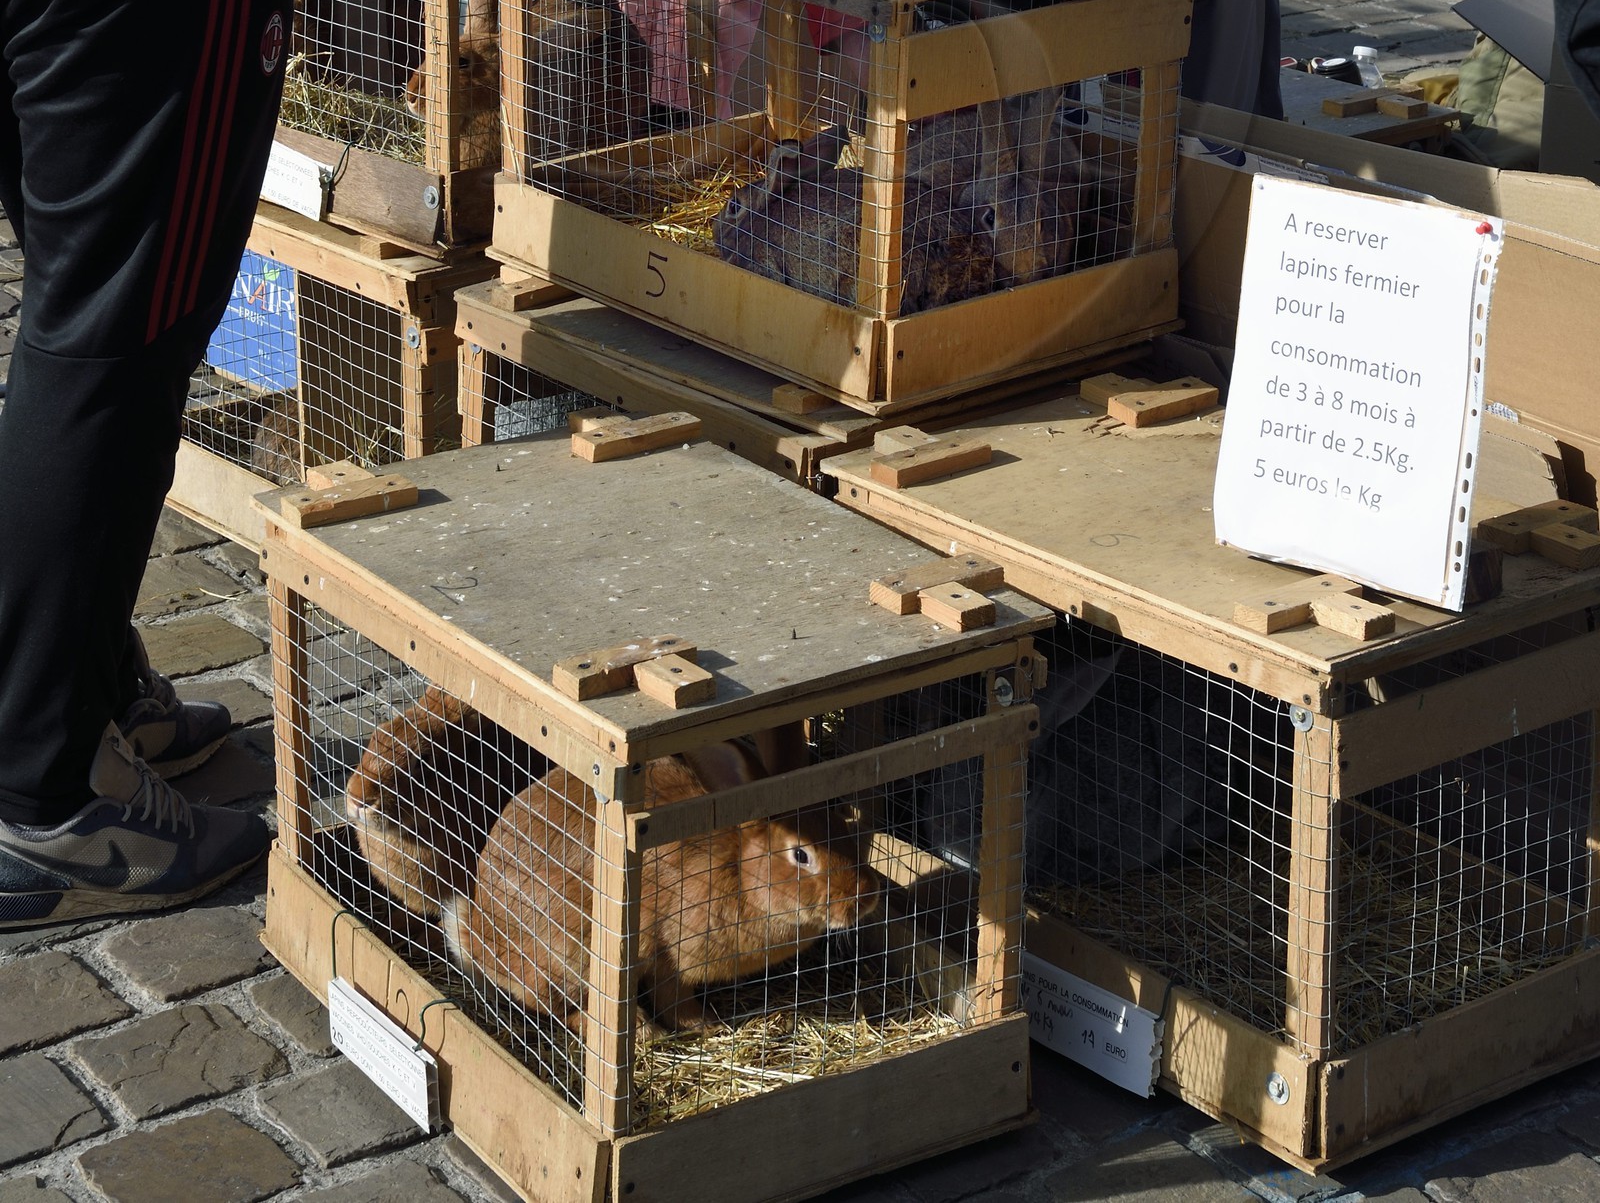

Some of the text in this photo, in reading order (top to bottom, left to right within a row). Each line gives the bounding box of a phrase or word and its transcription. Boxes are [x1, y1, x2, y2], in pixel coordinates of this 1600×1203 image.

[1284, 213, 1388, 250] A reserver
[645, 251, 668, 297] 5
[1280, 251, 1420, 298] lapins fermier
[1276, 296, 1345, 324] pour la
[1271, 340, 1421, 388] consommation
[1266, 375, 1416, 429] de 3 à 8 mois à
[1260, 418, 1414, 474] partir de 2.5Kg.
[1253, 458, 1382, 513] 5 euros le Kg
[1039, 977, 1058, 993] POUR
[1060, 988, 1069, 998] LA
[1072, 993, 1129, 1027] CONSOMMATION
[332, 1026, 344, 1046] 20
[1105, 1042, 1126, 1058] EURO
